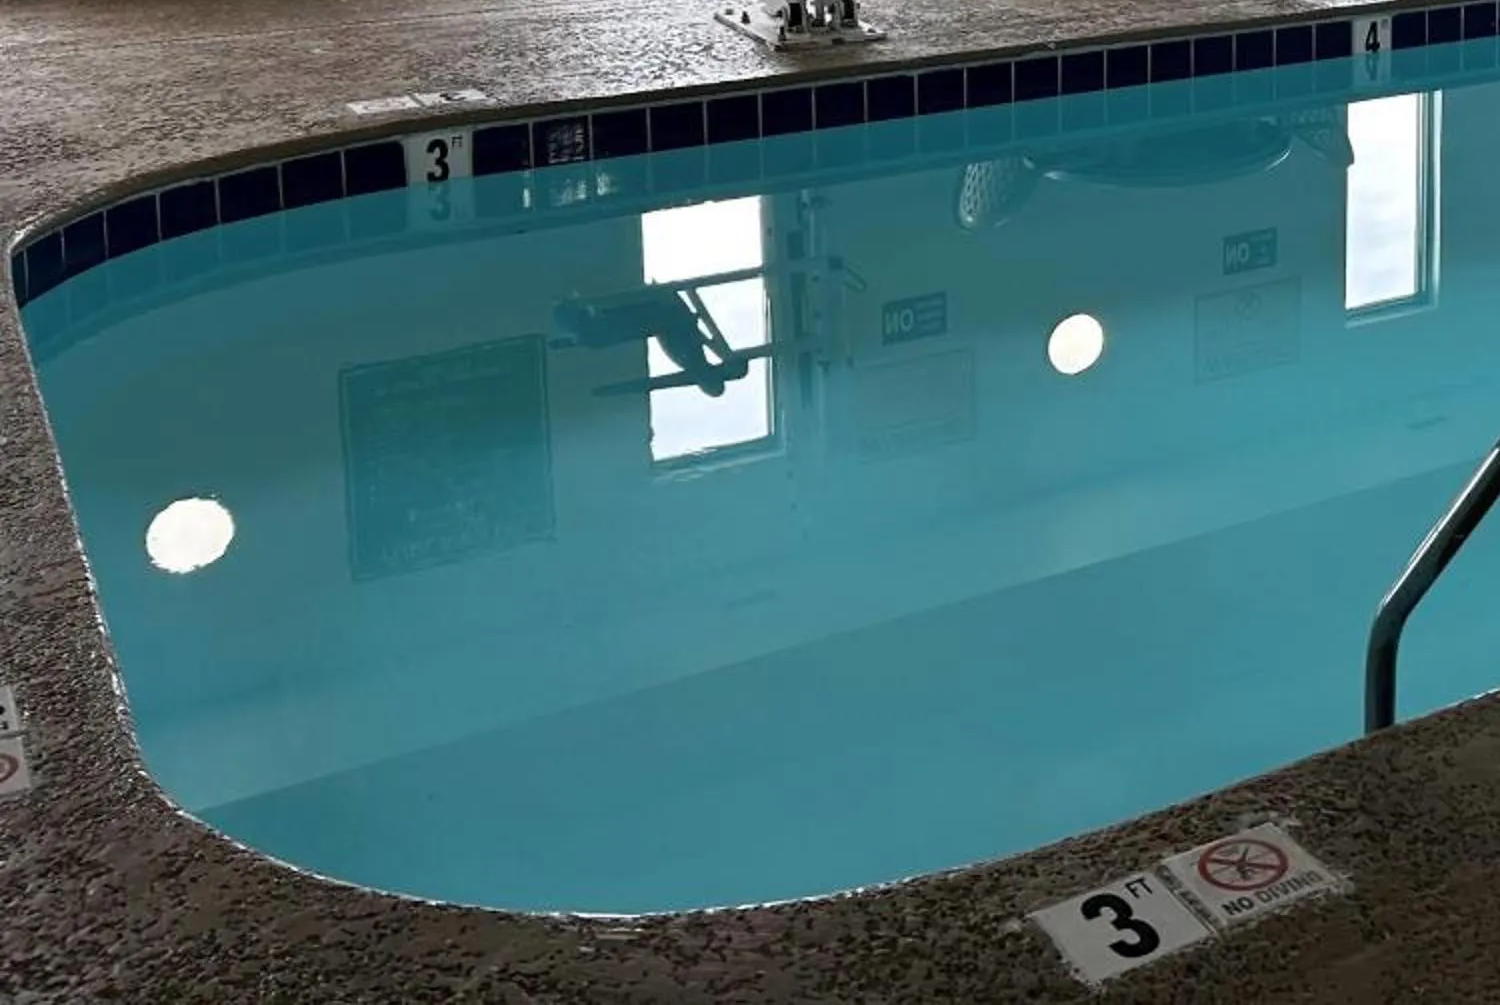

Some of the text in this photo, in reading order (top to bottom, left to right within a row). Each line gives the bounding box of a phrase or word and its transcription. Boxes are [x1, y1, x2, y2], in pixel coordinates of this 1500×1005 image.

[1365, 21, 1380, 52] 4
[427, 138, 449, 182] 3
[1222, 870, 1324, 915] NO DIVING
[1080, 877, 1161, 958] 3 FT
